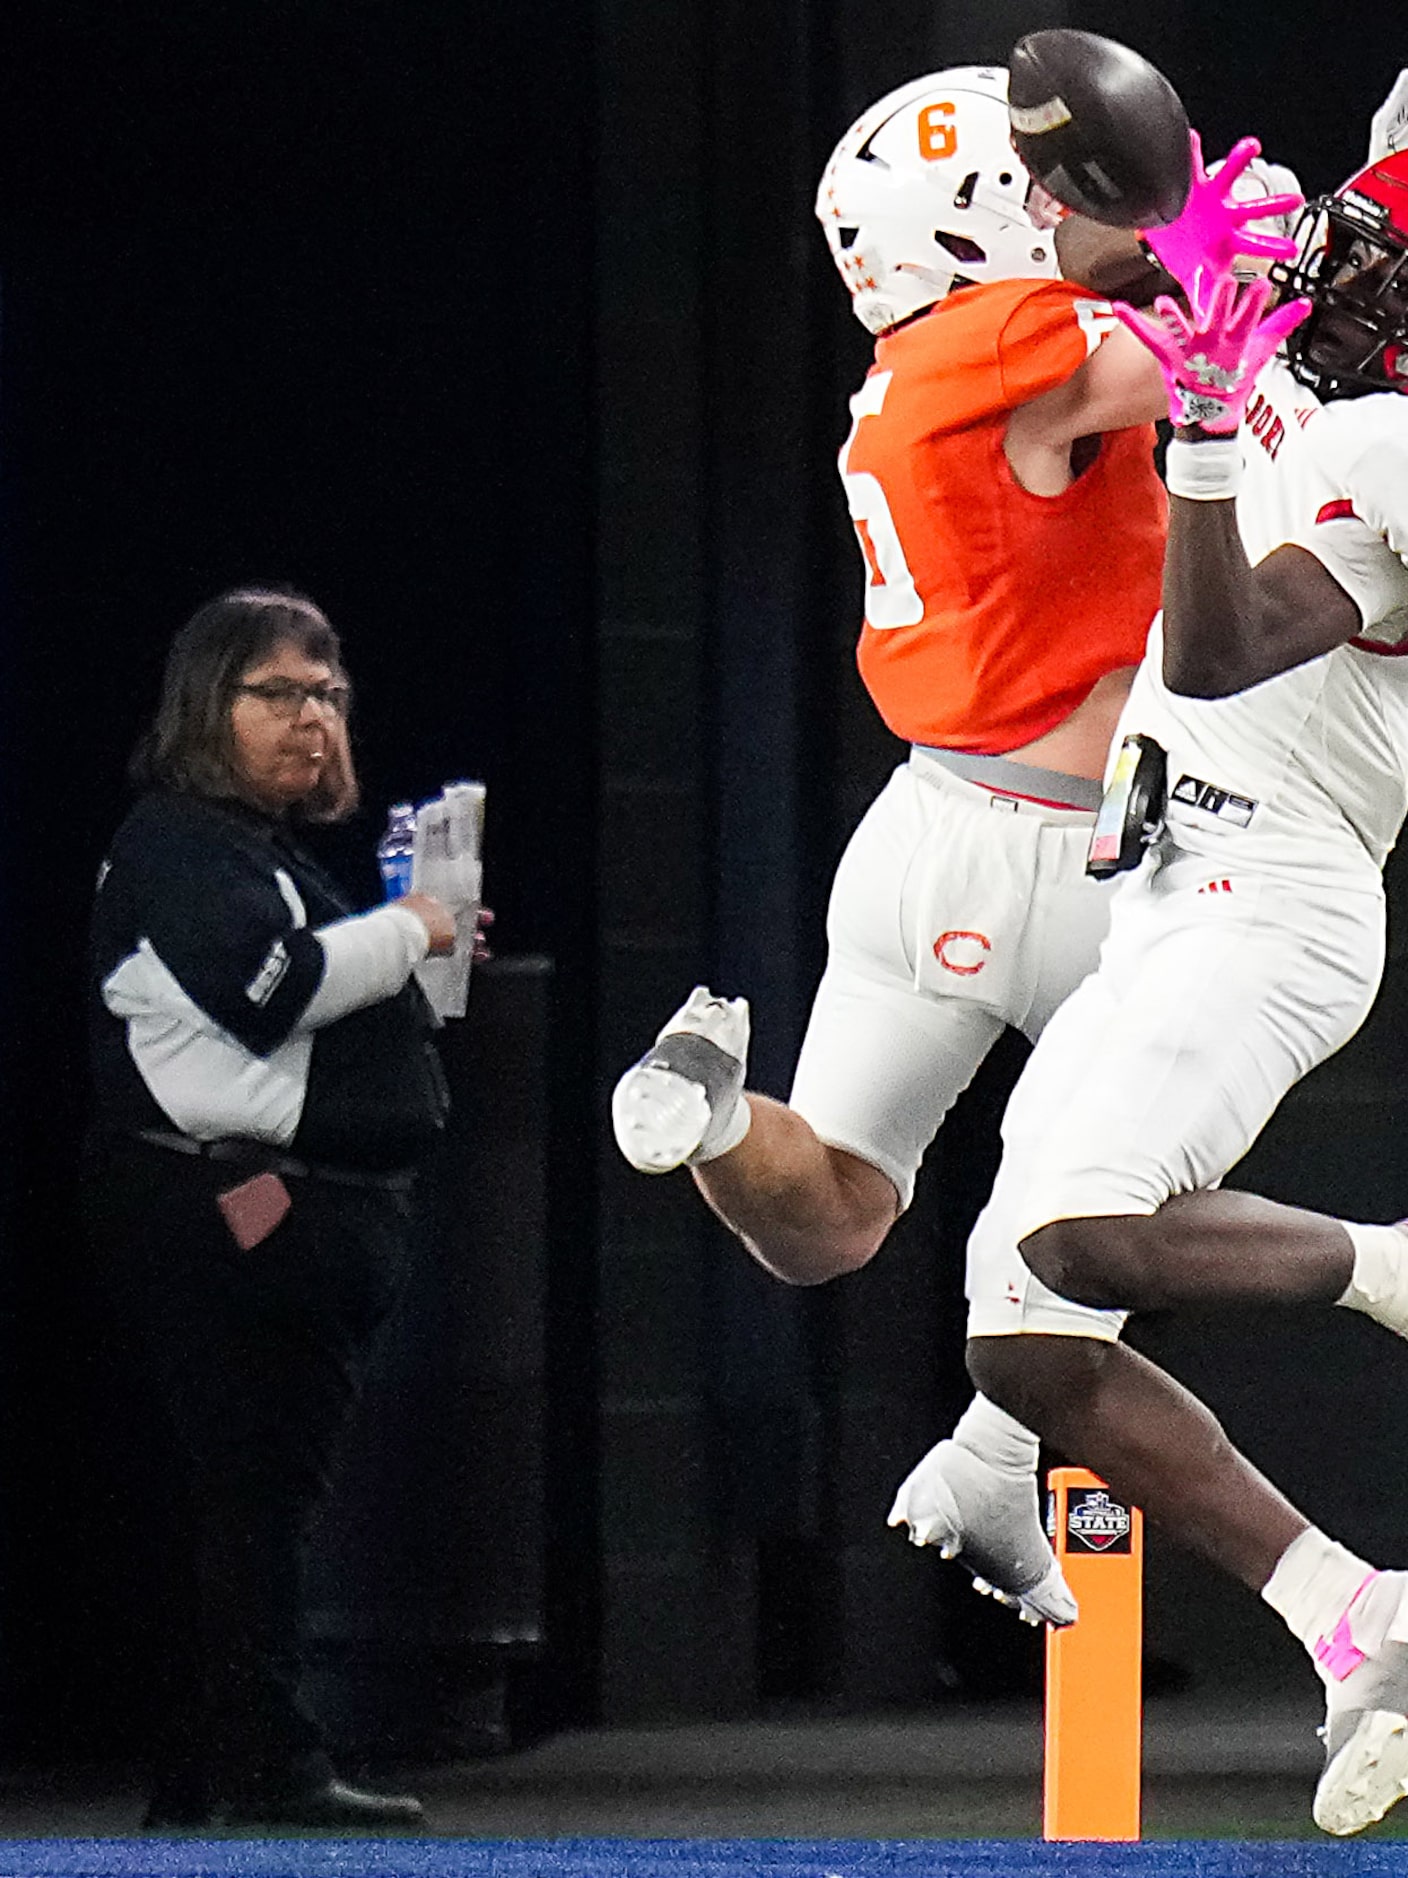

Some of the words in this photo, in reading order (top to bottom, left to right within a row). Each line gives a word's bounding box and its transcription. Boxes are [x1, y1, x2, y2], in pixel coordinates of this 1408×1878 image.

[917, 102, 958, 162] 6
[932, 930, 992, 976] C
[1069, 1516, 1127, 1529] STATE
